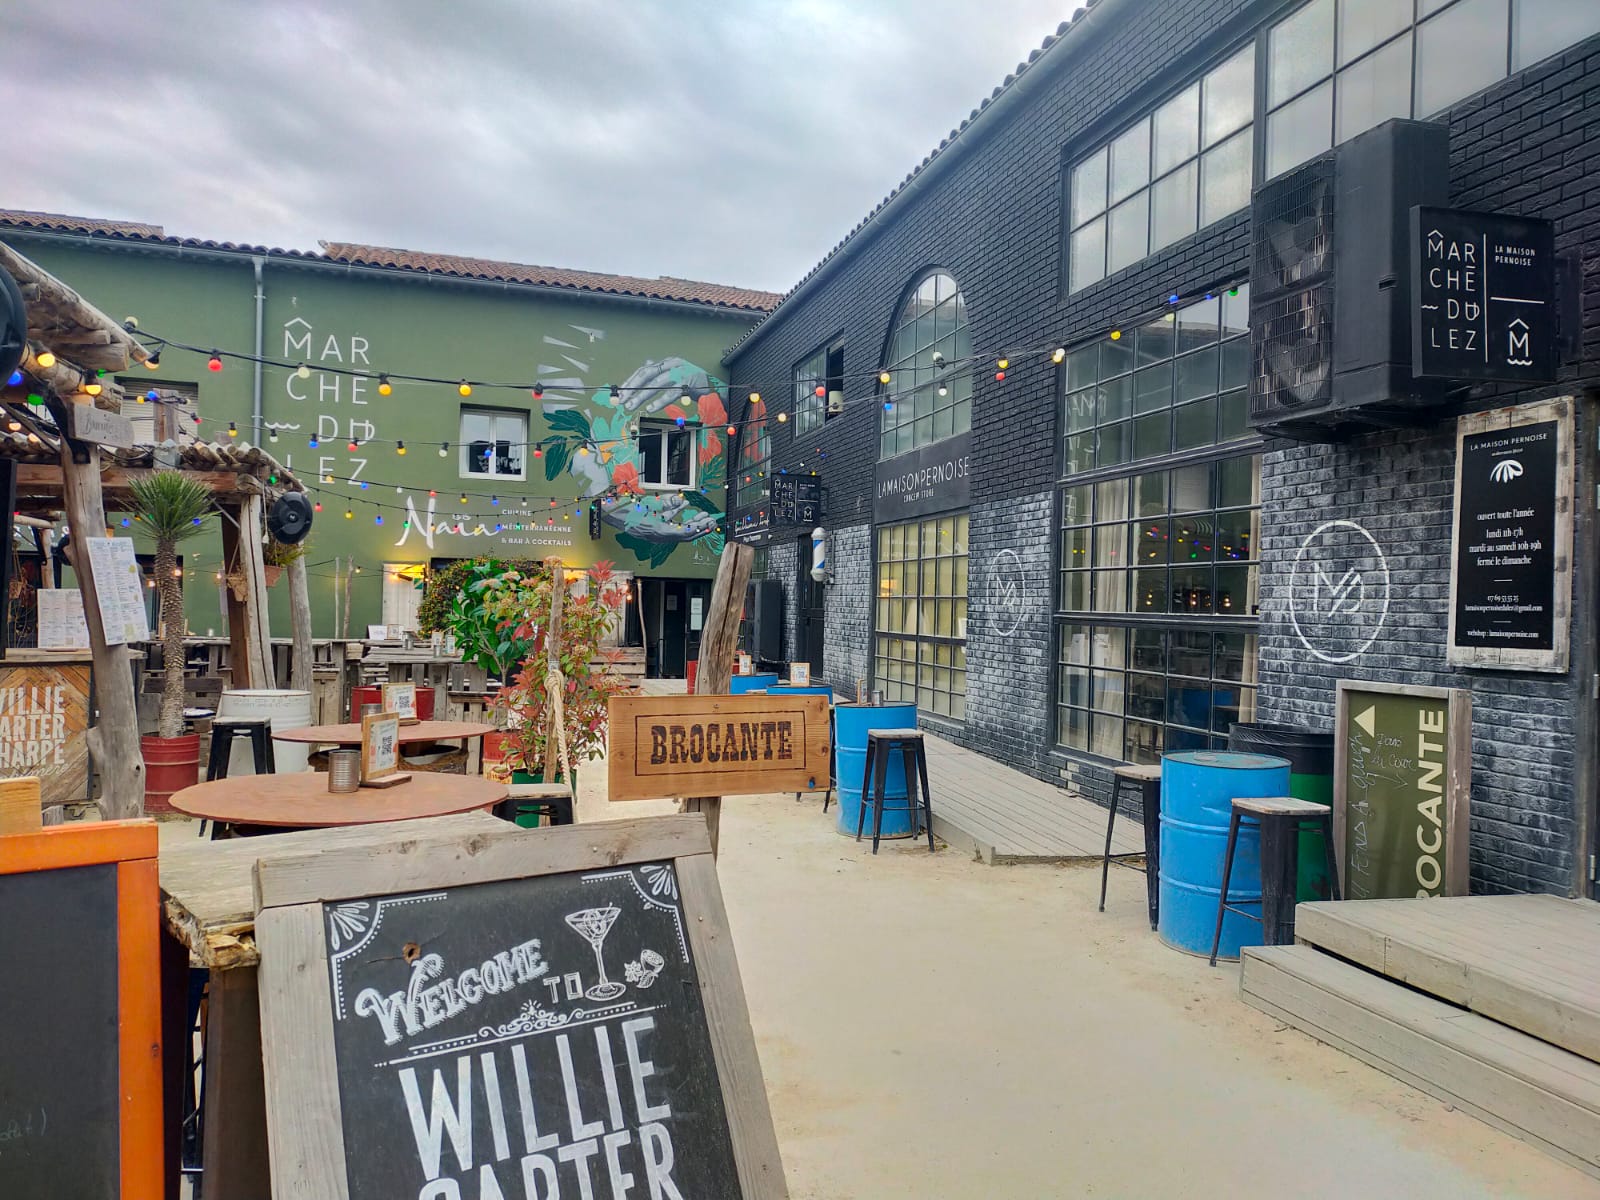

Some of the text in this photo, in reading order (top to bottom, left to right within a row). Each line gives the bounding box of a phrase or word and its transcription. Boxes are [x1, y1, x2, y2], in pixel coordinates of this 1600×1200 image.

[1428, 238, 1475, 263] MAR
[1495, 245, 1536, 256] LA MAISON
[1495, 255, 1532, 266] PERNOISE
[284, 328, 370, 365] MAR
[1431, 327, 1476, 350] LEZ
[1480, 439, 1509, 448] MAISON
[1511, 433, 1547, 444] PERNOISE
[774, 480, 793, 489] MAR
[774, 509, 793, 517] LEZ
[532, 538, 572, 546] COCKTAILS
[0, 713, 65, 741] ARTER
[0, 739, 65, 769] HARPE
[650, 720, 793, 765] BROCANTE
[1416, 709, 1444, 898] OCANTE
[355, 939, 585, 1046] WELCOME TO
[399, 1016, 671, 1181] WILLIE
[417, 1121, 684, 1200] TER
